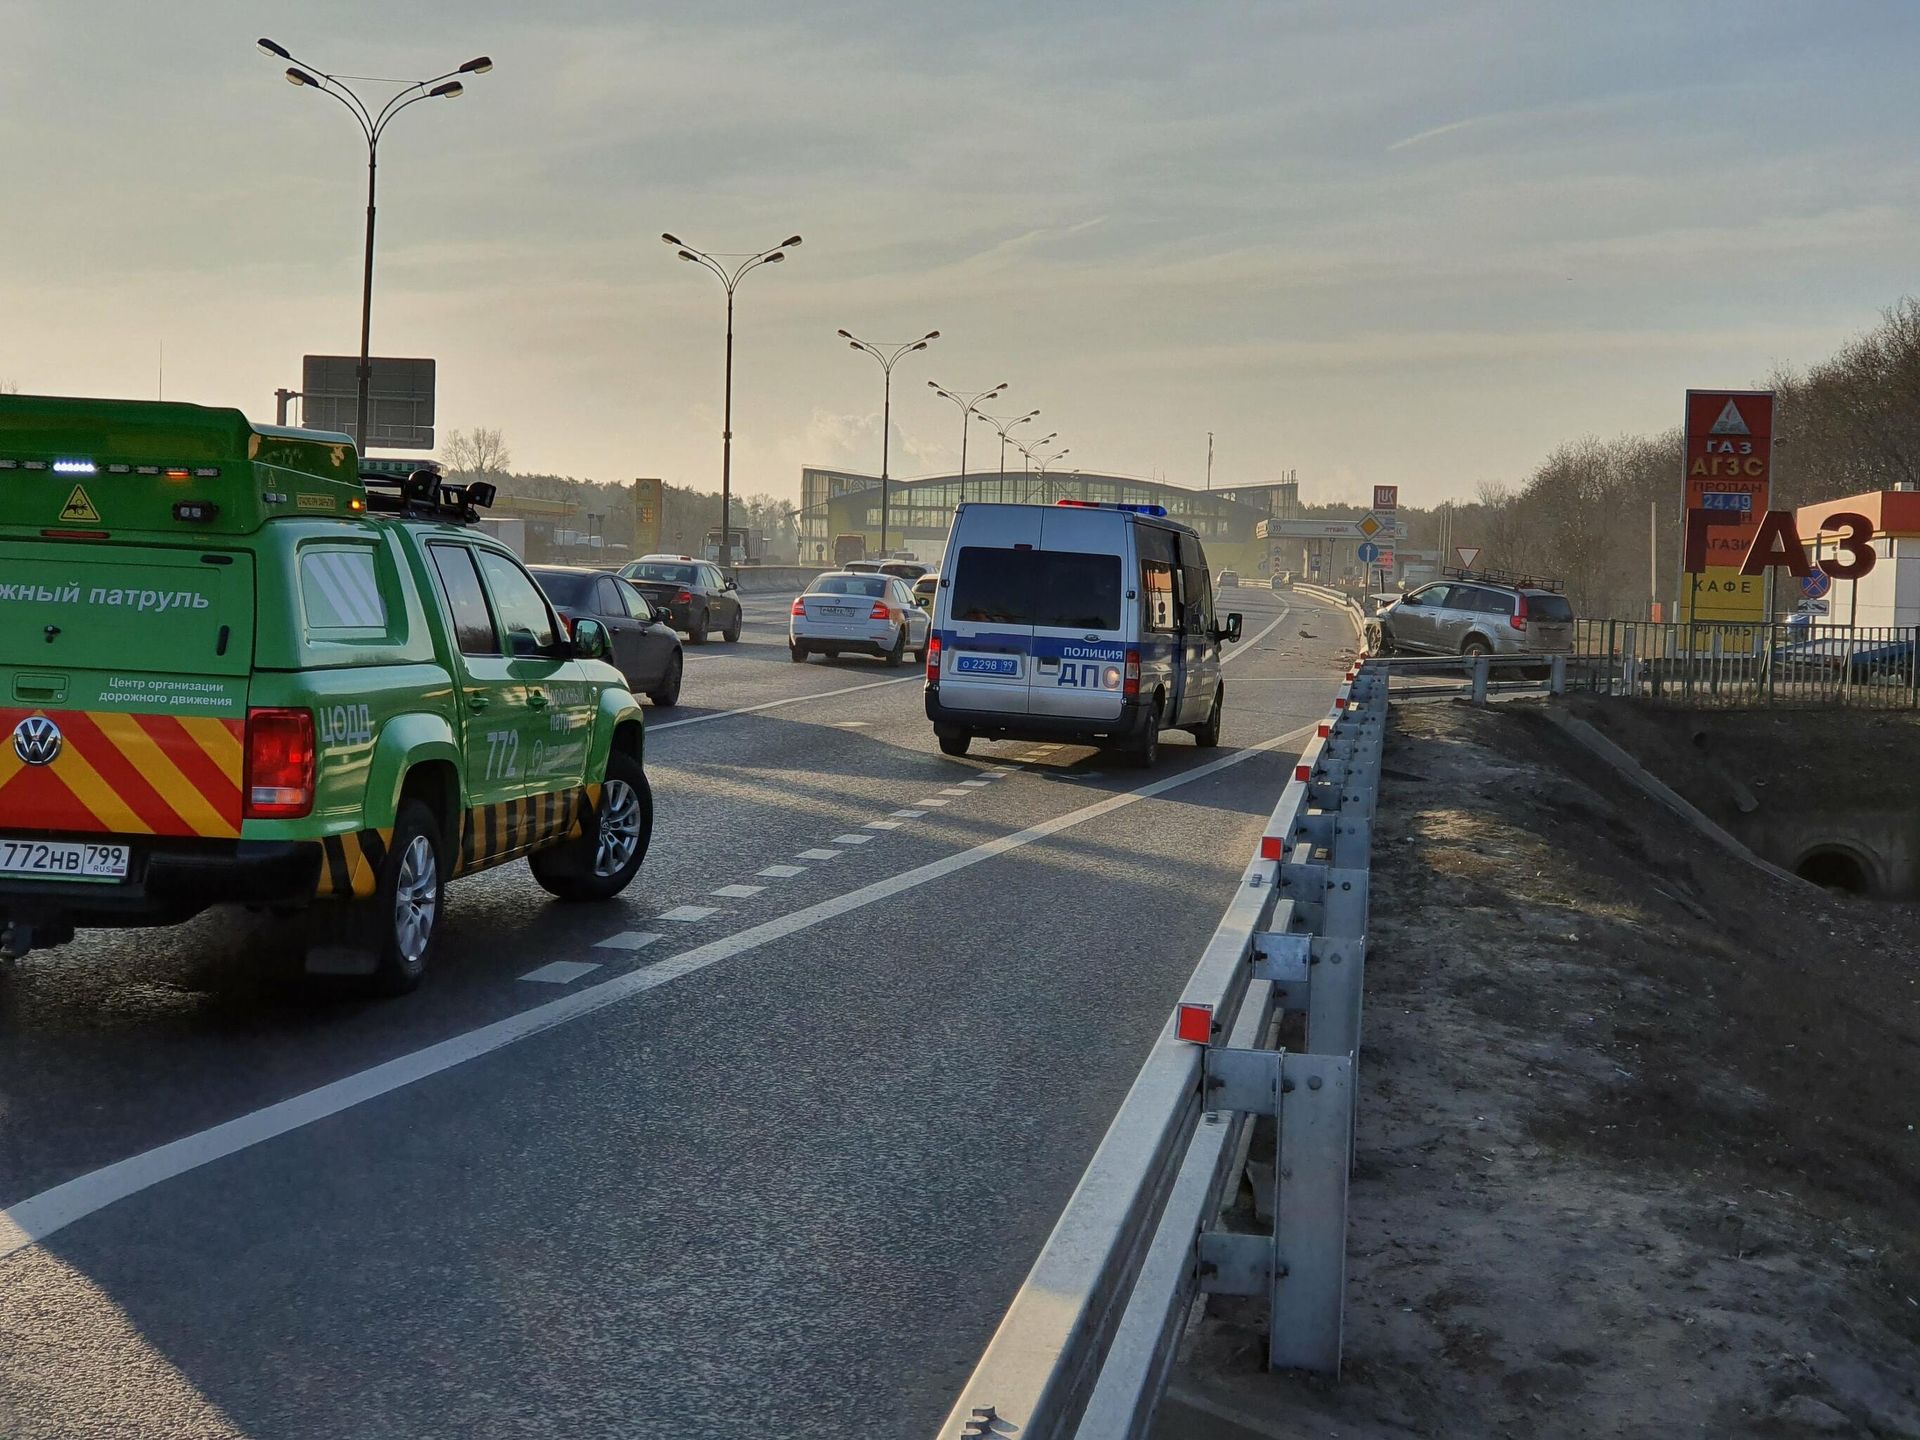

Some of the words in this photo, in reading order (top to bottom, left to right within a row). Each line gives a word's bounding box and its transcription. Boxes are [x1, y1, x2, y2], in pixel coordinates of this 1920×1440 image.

[1706, 439, 1753, 455] ГАЗ
[1690, 457, 1764, 477] АГЗС
[1693, 481, 1762, 493] ПРОПАН
[1684, 507, 1877, 579] ГАЗ
[1693, 580, 1751, 594] КАФЕ
[89, 587, 210, 613] патруль
[1063, 647, 1123, 660] ПОЛИЦИЯ
[971, 659, 998, 670] 2298
[1002, 660, 1014, 669] 99
[1058, 664, 1120, 689] ДПС
[109, 677, 146, 691] Центр
[148, 680, 224, 693] организации
[99, 691, 167, 706] дорожного
[169, 694, 233, 707] движения
[320, 704, 371, 747] ЦОДД
[485, 728, 519, 781] 772
[0, 843, 81, 871] 772НВ
[86, 845, 124, 867] 799
[93, 865, 111, 873] RUS
